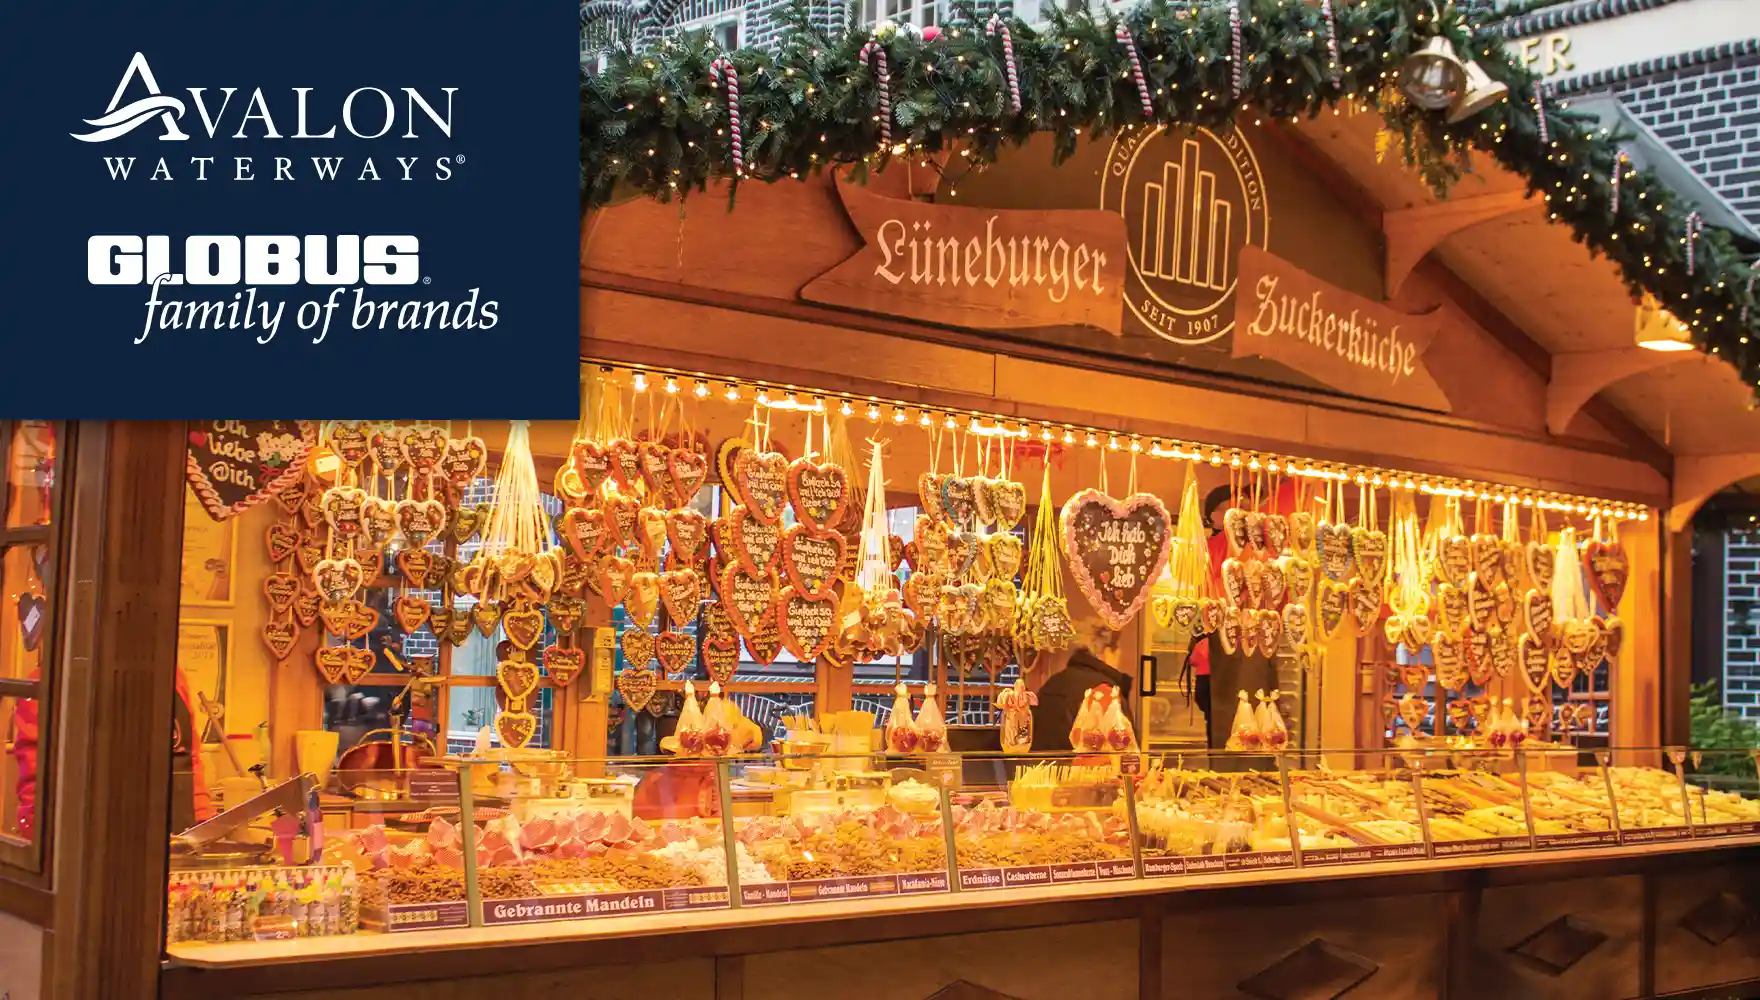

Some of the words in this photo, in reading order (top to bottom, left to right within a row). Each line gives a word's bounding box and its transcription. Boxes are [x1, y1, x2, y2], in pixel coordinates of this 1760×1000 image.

[1223, 133, 1261, 211] DITION
[875, 215, 1107, 303] Lüneburger
[1141, 299, 1176, 332] SEIT
[1187, 314, 1219, 335] 1907
[1246, 274, 1417, 384] Zuckerküche
[1098, 520, 1121, 542] Ich
[1121, 521, 1146, 543] hab
[1108, 543, 1136, 565] Dich
[1110, 565, 1135, 588] lieb
[963, 874, 1000, 885] Erdnüsse
[494, 900, 582, 919] Gebrannte
[586, 895, 655, 914] Mandeln
